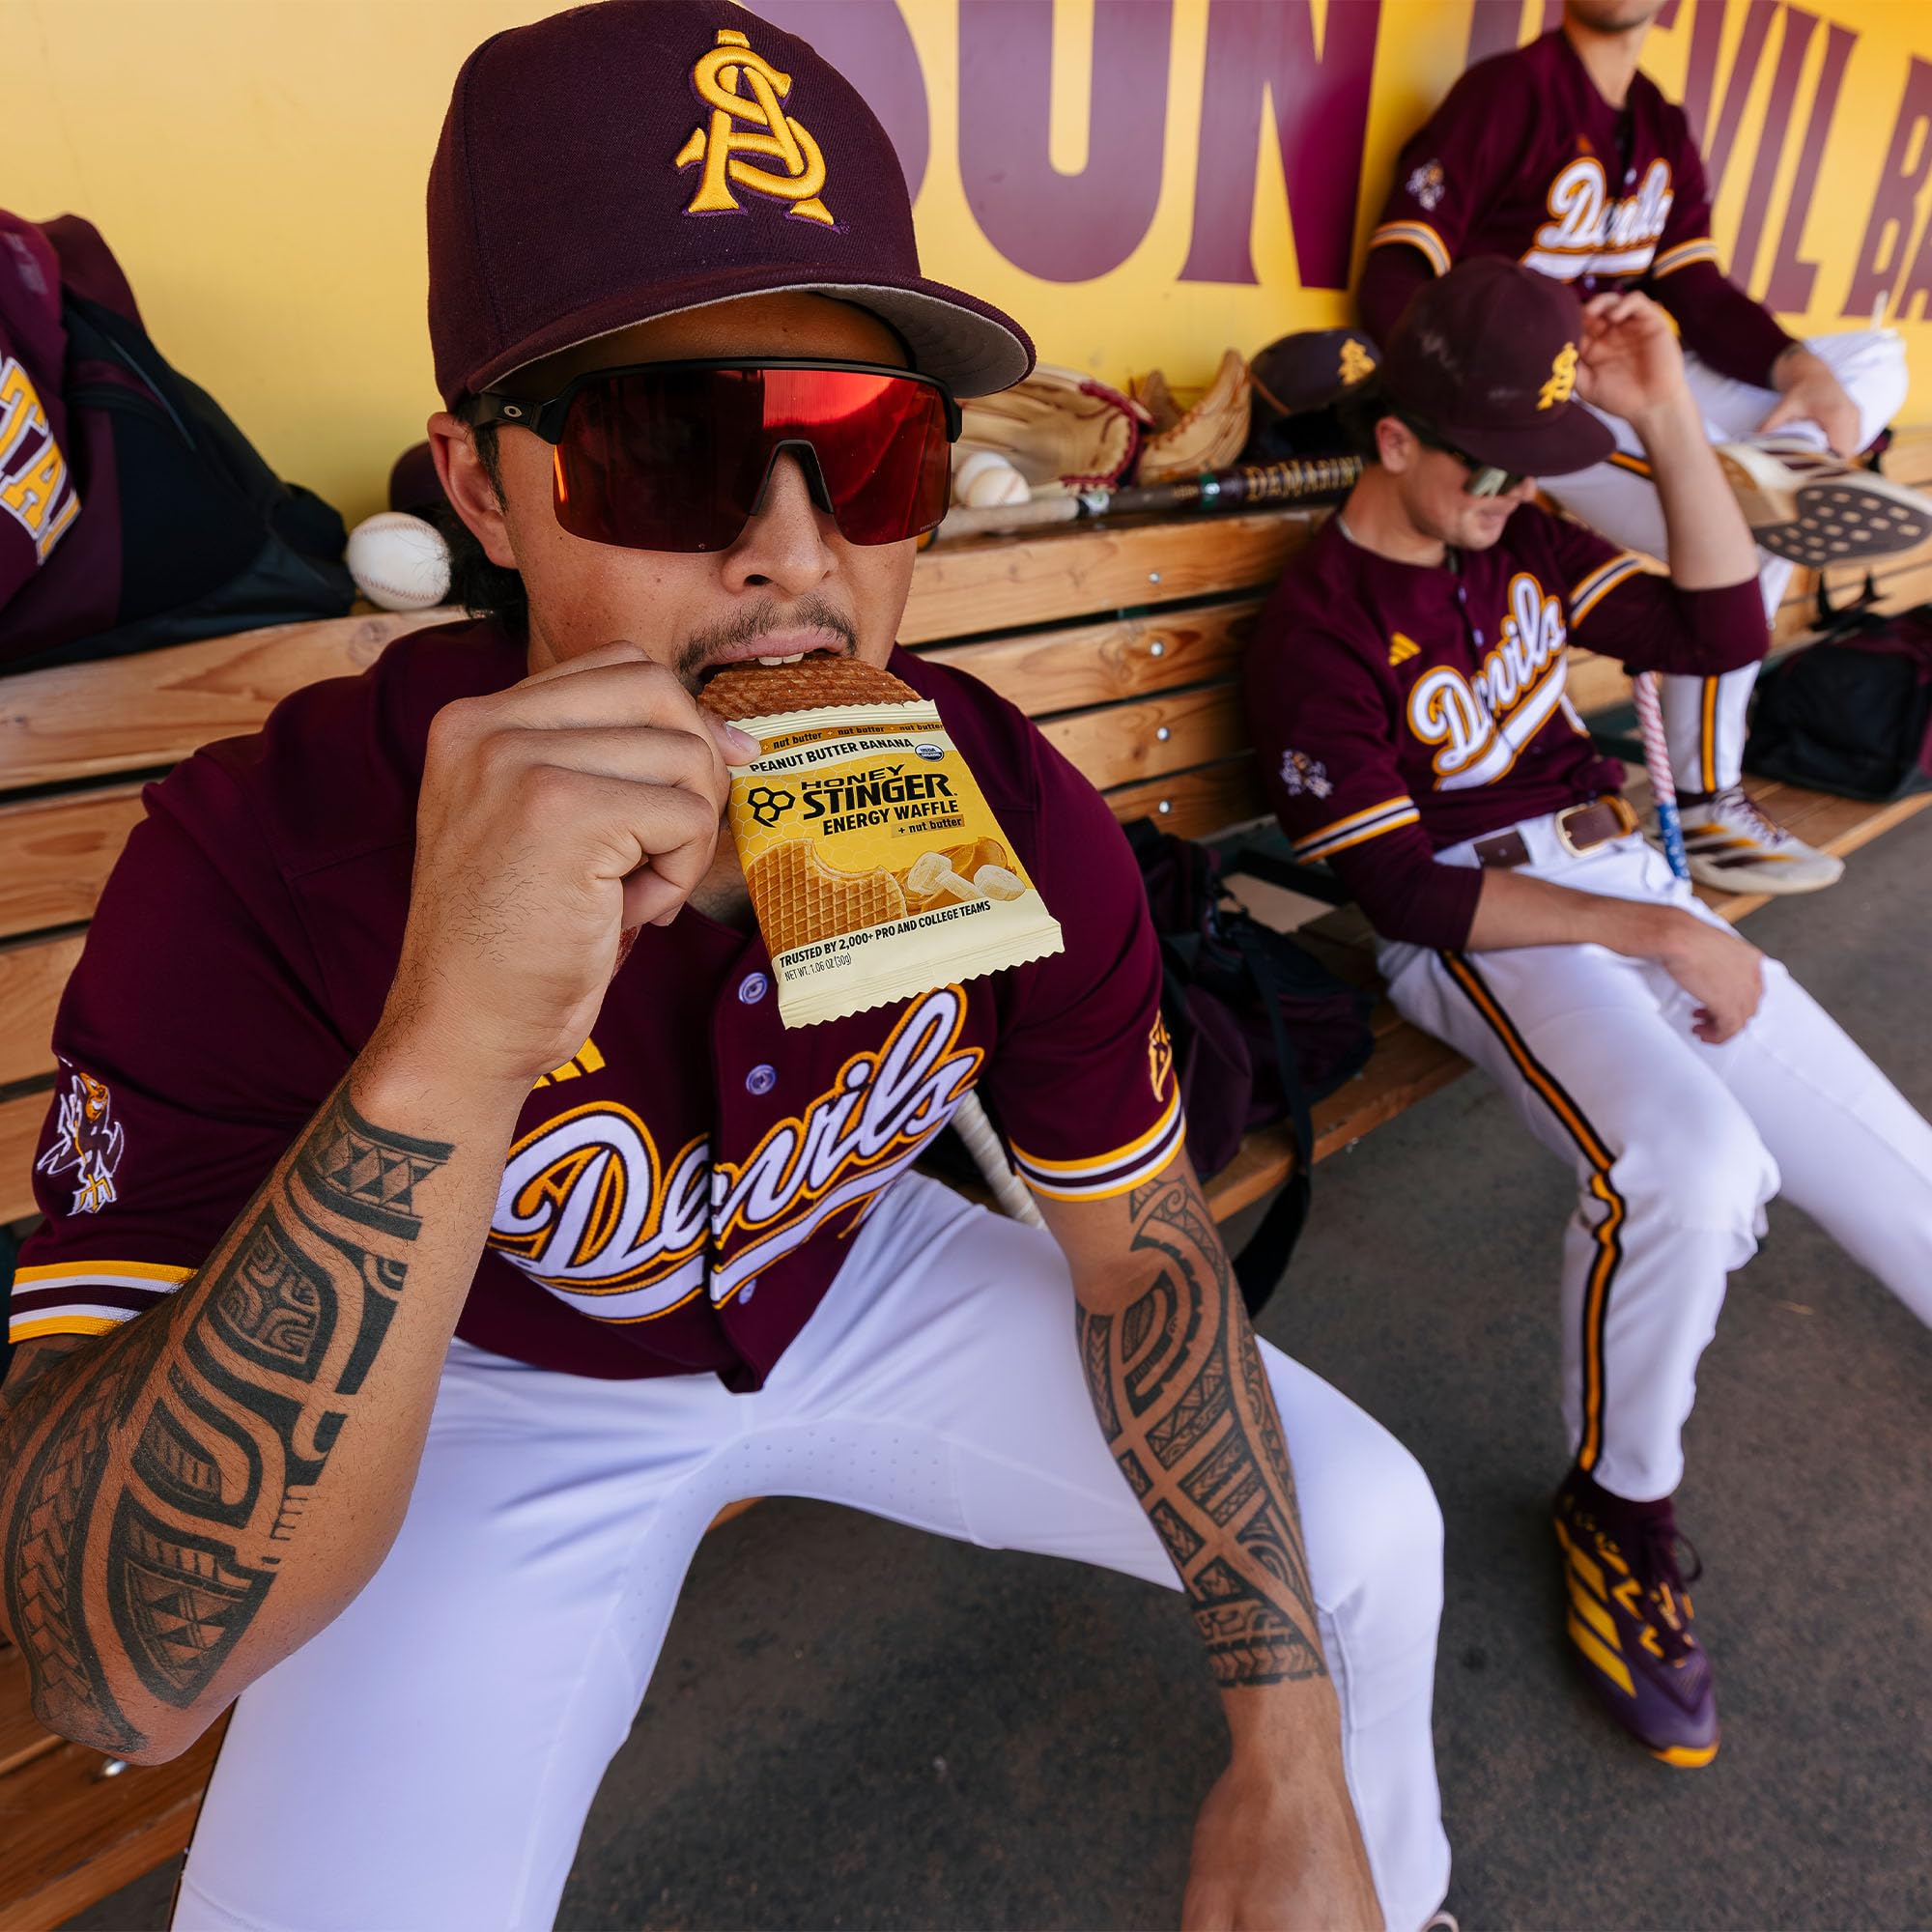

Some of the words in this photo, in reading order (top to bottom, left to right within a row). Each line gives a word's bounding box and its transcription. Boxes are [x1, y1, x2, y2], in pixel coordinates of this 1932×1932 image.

[731, 0, 1381, 290] UN
[773, 736, 790, 750] nut
[791, 731, 823, 745] butter
[838, 727, 855, 736] nut
[857, 724, 885, 735] butter
[749, 753, 805, 773] PEANUT
[808, 742, 859, 762] BUTTER
[859, 738, 915, 751] BANANA
[801, 764, 905, 790] HONEY
[803, 773, 954, 820] STINGER
[823, 808, 891, 836] ENERGY
[893, 800, 959, 821] WAFFLE
[909, 821, 929, 834] nut
[930, 816, 962, 830] butter
[780, 946, 823, 968] TRUSTED
[824, 941, 838, 953] BY
[838, 932, 874, 951] 2,000+
[875, 925, 895, 941] PRO
[897, 920, 918, 934] AND
[919, 911, 959, 928] COLLEGE
[959, 900, 992, 917] TEAMS
[784, 970, 798, 981] NET
[798, 966, 810, 979] WT.
[810, 961, 825, 974] 1.06
[826, 957, 835, 969] OZ
[835, 952, 852, 968] (30g)
[488, 983, 985, 1299] Devils
